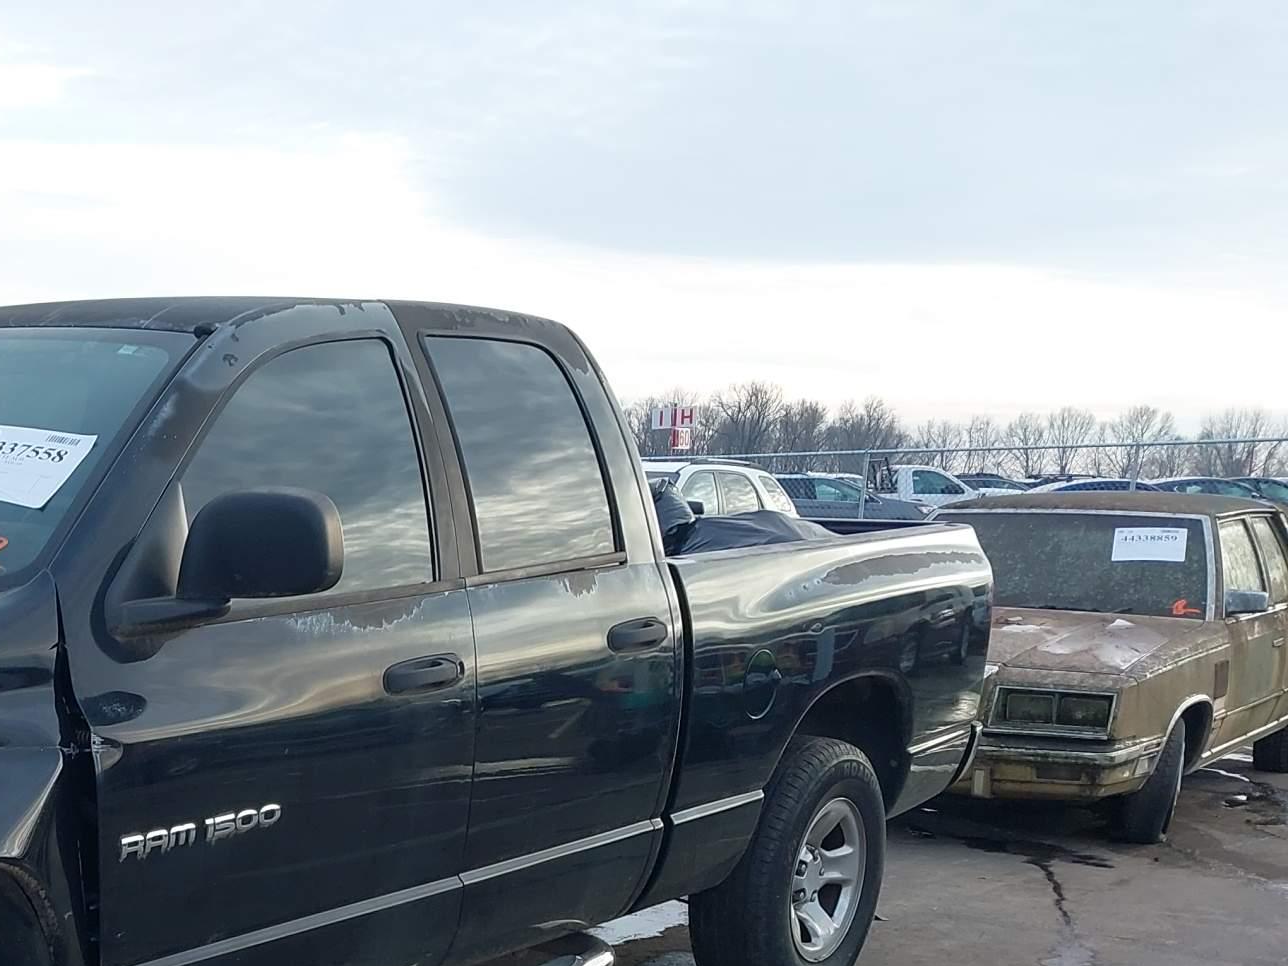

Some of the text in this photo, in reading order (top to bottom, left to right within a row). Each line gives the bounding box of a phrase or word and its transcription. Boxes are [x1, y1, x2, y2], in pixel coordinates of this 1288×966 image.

[680, 408, 694, 425] H
[119, 803, 282, 863] RAM 1500
